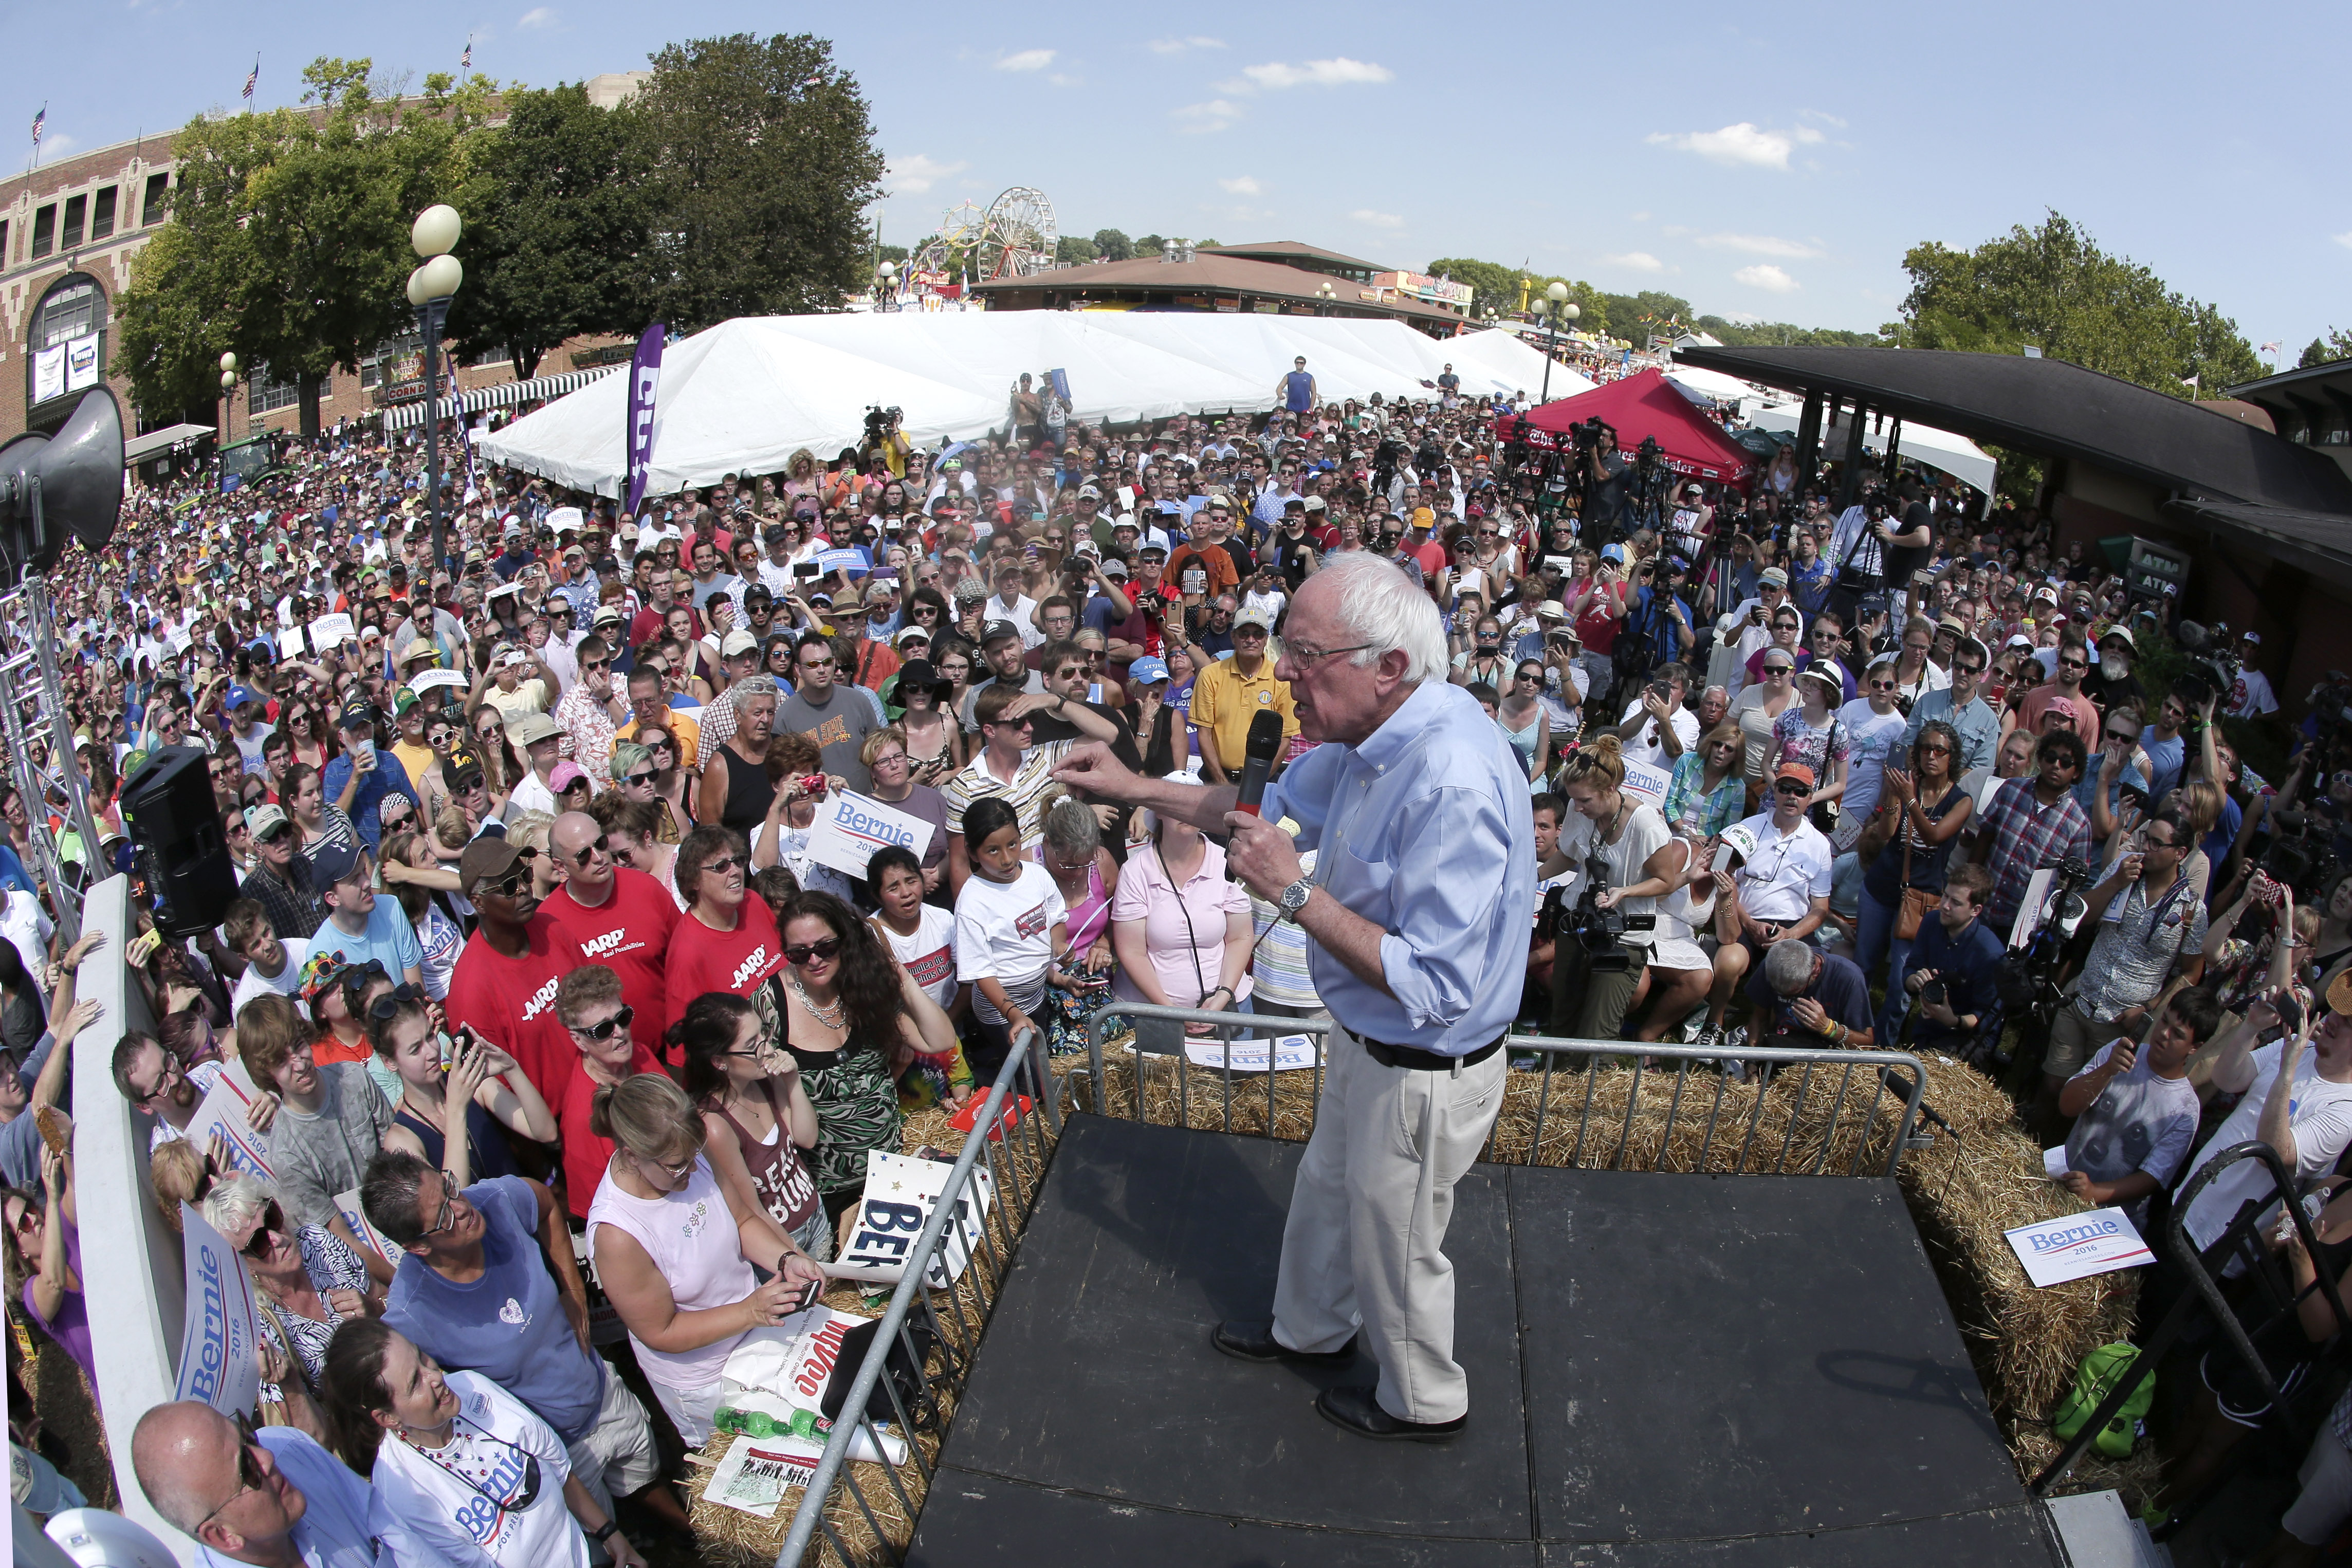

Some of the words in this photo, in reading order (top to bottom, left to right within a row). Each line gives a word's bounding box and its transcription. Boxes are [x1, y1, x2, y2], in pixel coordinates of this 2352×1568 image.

[74, 349, 93, 362] Iowa
[74, 358, 93, 370] Banks
[392, 358, 420, 369] CHEESE
[399, 365, 416, 374] STICK
[389, 384, 416, 399] CORN
[1529, 429, 1554, 446] The
[551, 510, 579, 522] Bernie
[817, 551, 857, 562] Bernie
[2142, 554, 2179, 573] ATM
[316, 617, 347, 632] Bernie
[820, 714, 845, 740] STATE
[834, 801, 914, 848] Bernie
[856, 841, 878, 855] 2016
[602, 950, 614, 958] Real
[615, 942, 646, 955] Possibilities
[730, 947, 765, 989] AARP
[934, 955, 944, 964] de
[756, 968, 765, 979] Real
[522, 977, 559, 1021] AARP
[545, 1002, 556, 1014] Real
[247, 1131, 267, 1158] 2016
[767, 1164, 815, 1225] BUM
[2027, 1220, 2119, 1251] Bernie
[380, 1236, 399, 1262] 2016
[2073, 1244, 2098, 1255] 2016
[2064, 1250, 2116, 1266] BERNIESANDERS.COM
[190, 1244, 220, 1406] Bernie
[231, 1317, 241, 1359] 2016
[238, 1300, 250, 1388] BERNIESANDERS.COM
[795, 1342, 811, 1366] EMPLOYEE
[787, 1361, 800, 1379] OWNED
[473, 1393, 484, 1413] Bernie
[782, 1435, 803, 1443] Lifetime
[455, 1443, 527, 1541] Bernie
[497, 1530, 510, 1549] FOR
